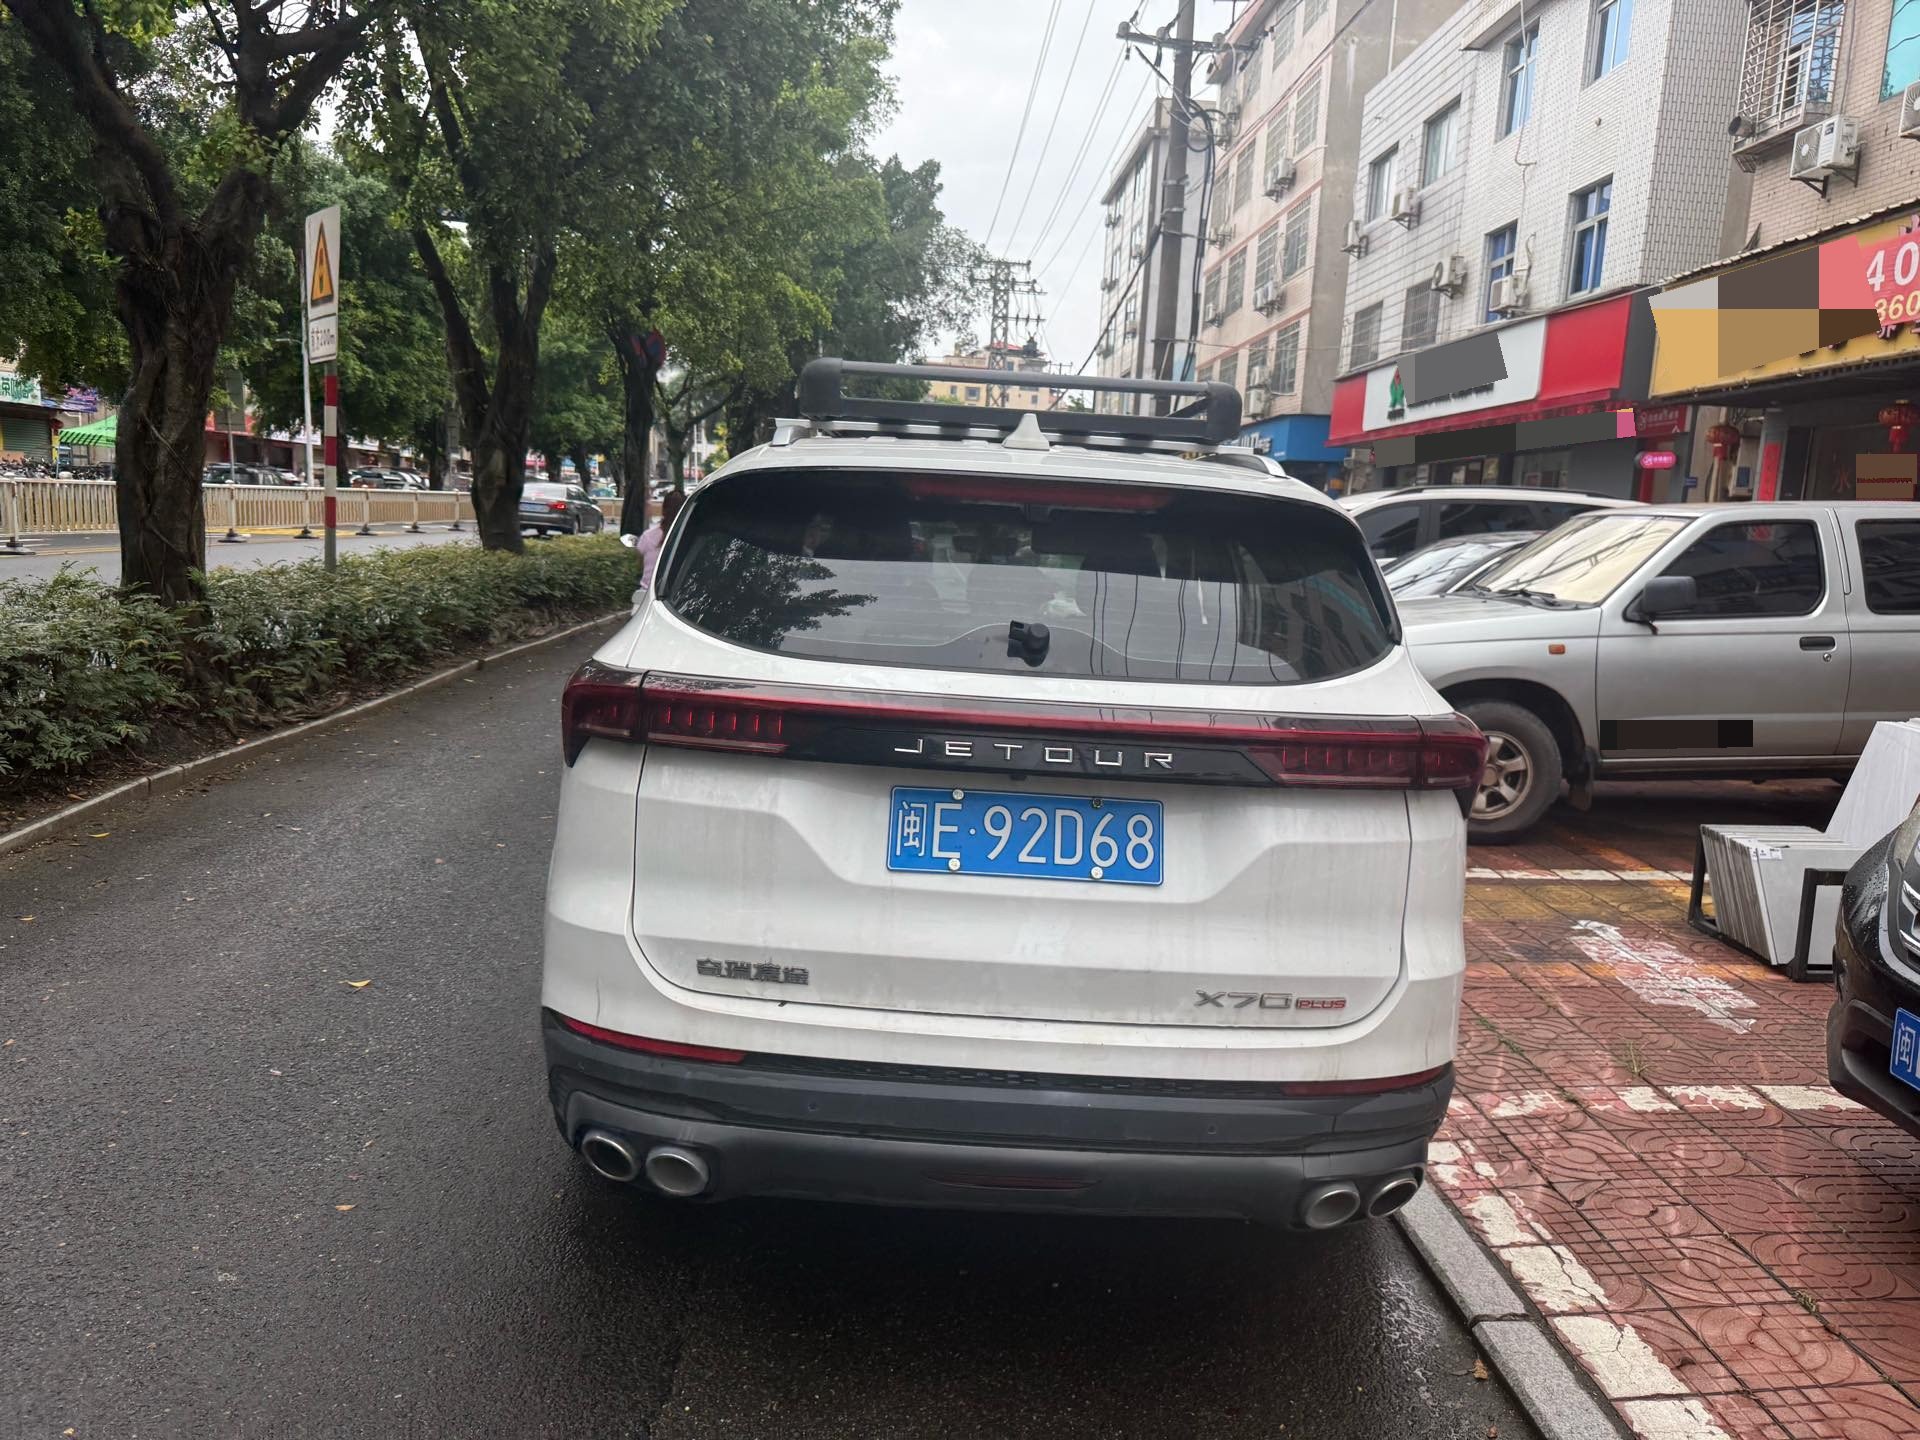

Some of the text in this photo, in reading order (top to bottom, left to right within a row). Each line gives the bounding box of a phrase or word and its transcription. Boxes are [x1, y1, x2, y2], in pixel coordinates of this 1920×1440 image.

[894, 738, 1172, 768] JETOUR
[1194, 989, 1347, 1010] X70 PLUS
